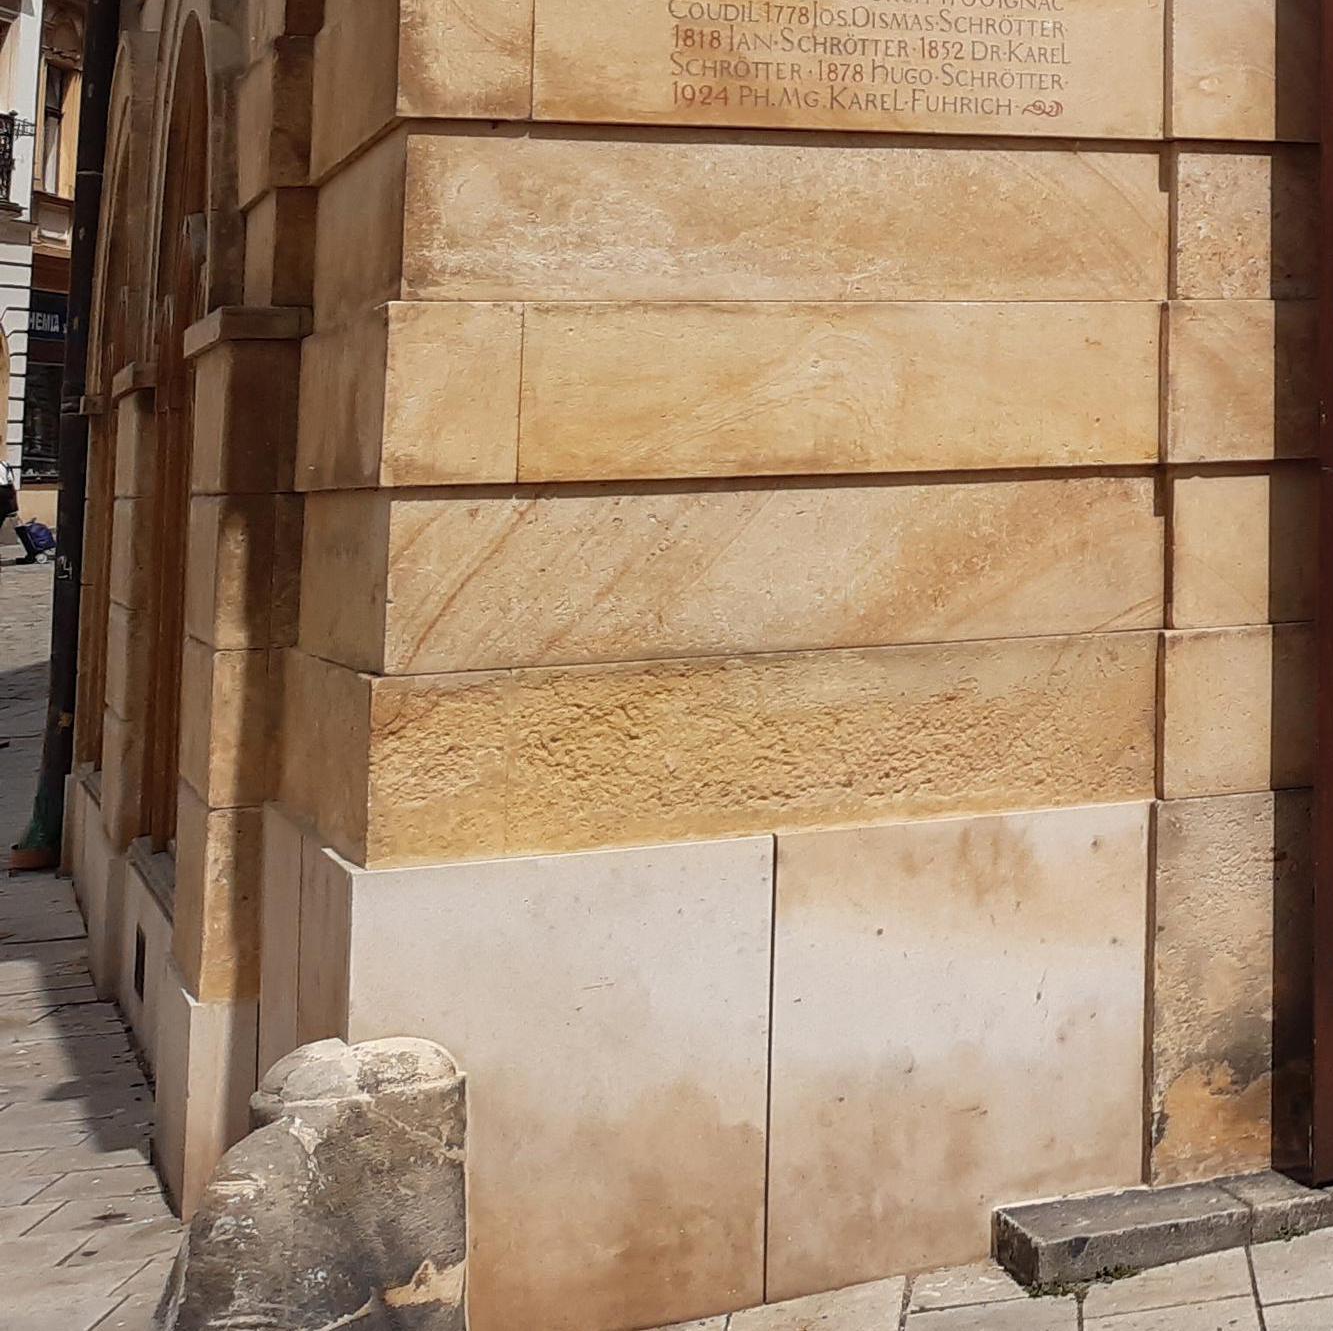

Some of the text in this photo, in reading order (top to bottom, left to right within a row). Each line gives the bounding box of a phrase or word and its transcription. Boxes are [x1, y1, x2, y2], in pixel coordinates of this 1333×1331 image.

[763, 1, 809, 24] 1778
[919, 37, 965, 60] 1852
[818, 59, 864, 83] 1878
[673, 81, 729, 107] 1924
